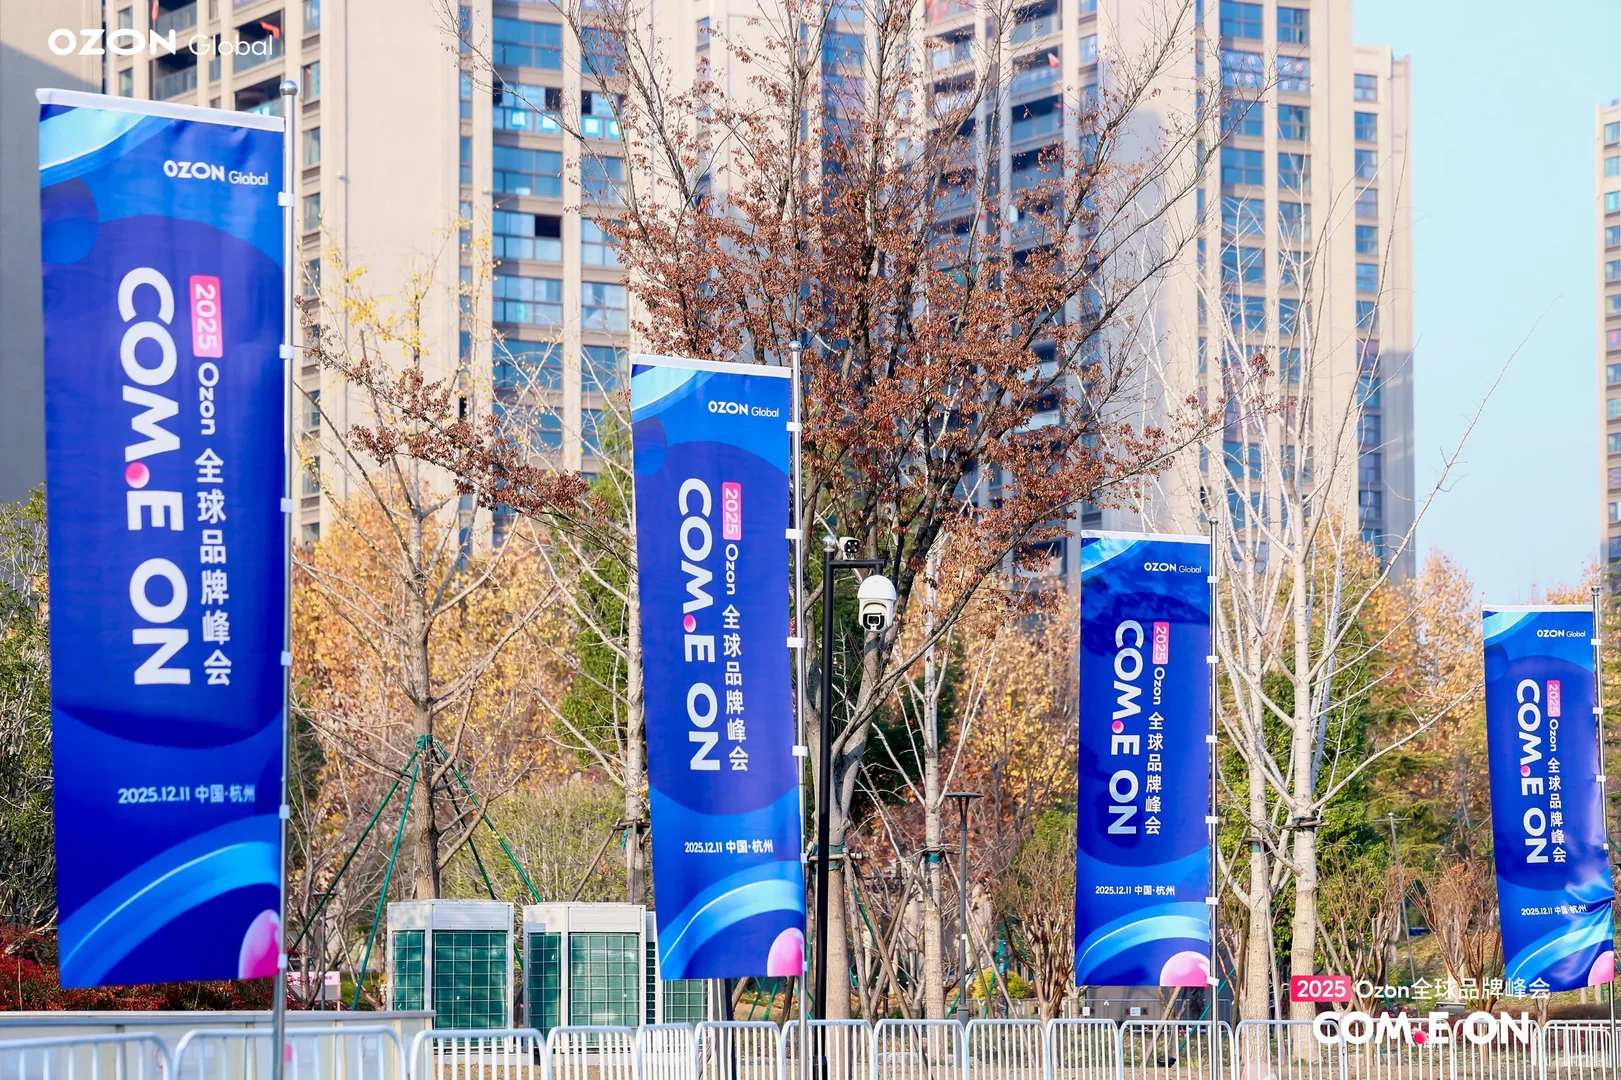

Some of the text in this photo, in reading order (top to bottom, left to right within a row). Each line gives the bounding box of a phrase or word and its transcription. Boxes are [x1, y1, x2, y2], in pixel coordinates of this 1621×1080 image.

[163, 160, 268, 186] OZON Global
[708, 400, 779, 418] OZON Global
[195, 283, 232, 686] 2025 Ozon 全球品牌峰会
[1144, 562, 1201, 574] OZON Global
[129, 558, 191, 685] ON
[722, 487, 749, 772] 2025 Ozon 全球品牌峰会
[1537, 629, 1564, 638] OZON
[1549, 684, 1559, 714] 2025
[686, 682, 721, 771] ON
[1144, 626, 1166, 835] 2025 Ozon 全球品牌峰会
[1549, 719, 1559, 752] Ozon
[118, 786, 190, 804] 2025.12.11
[1107, 769, 1138, 835] ON
[684, 841, 723, 853] 2025.12.11
[1523, 807, 1548, 864] ON
[1095, 886, 1131, 895] 2025.12.11
